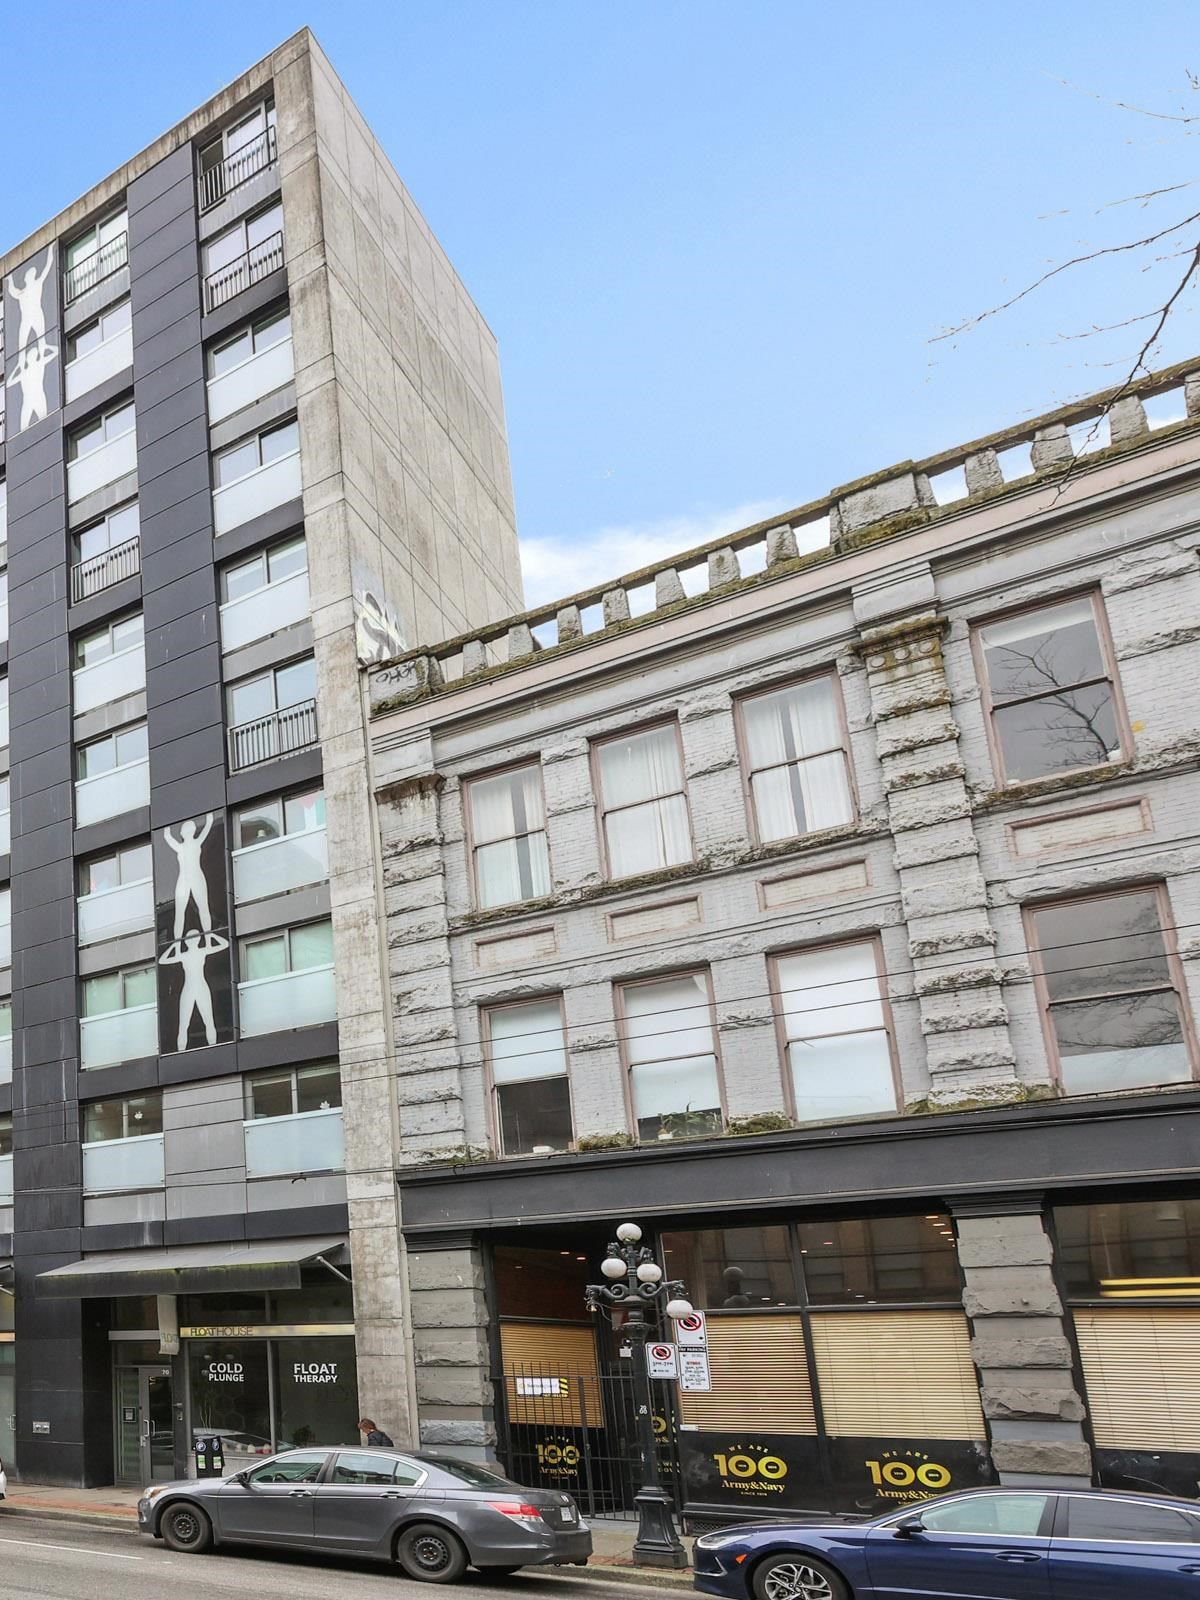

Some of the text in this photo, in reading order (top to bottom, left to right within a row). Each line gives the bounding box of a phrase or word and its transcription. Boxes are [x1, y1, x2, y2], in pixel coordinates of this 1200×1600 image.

[217, 1326, 253, 1336] HOUSE
[209, 1363, 243, 1374] COLD
[294, 1363, 337, 1374] FLOAT
[208, 1373, 244, 1382] PLUNGE
[294, 1375, 338, 1383] THERAPY
[535, 1444, 580, 1465] 100
[748, 1445, 769, 1453] ARE
[905, 1450, 928, 1460] ARE
[713, 1454, 788, 1479] 100
[865, 1461, 951, 1488] 100
[721, 1480, 785, 1493] Army&Navy
